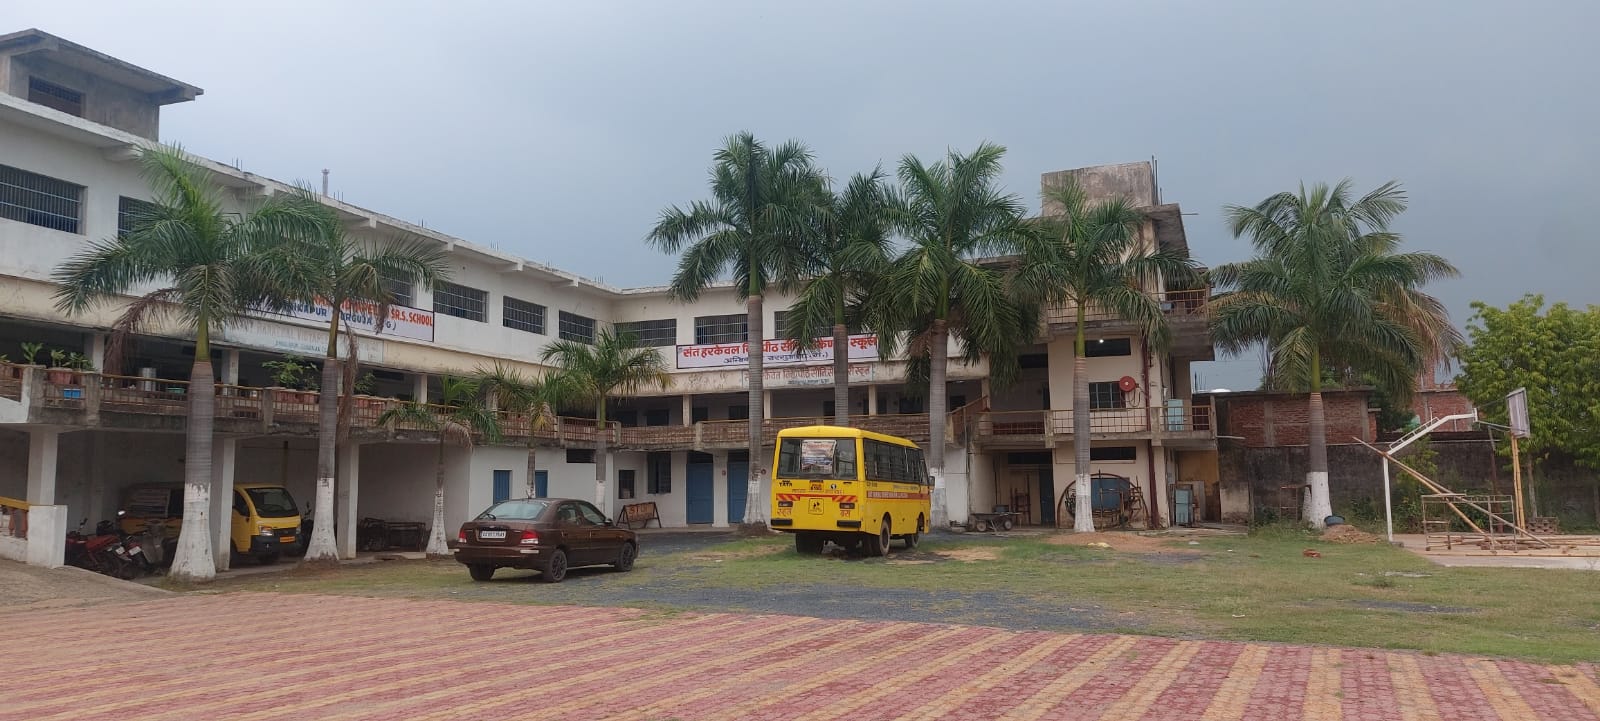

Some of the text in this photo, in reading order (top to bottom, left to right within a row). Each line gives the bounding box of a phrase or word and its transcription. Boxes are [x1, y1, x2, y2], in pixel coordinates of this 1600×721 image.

[408, 311, 433, 327] SCHOOL
[683, 346, 699, 358] संत
[700, 344, 740, 359] हरकेवल
